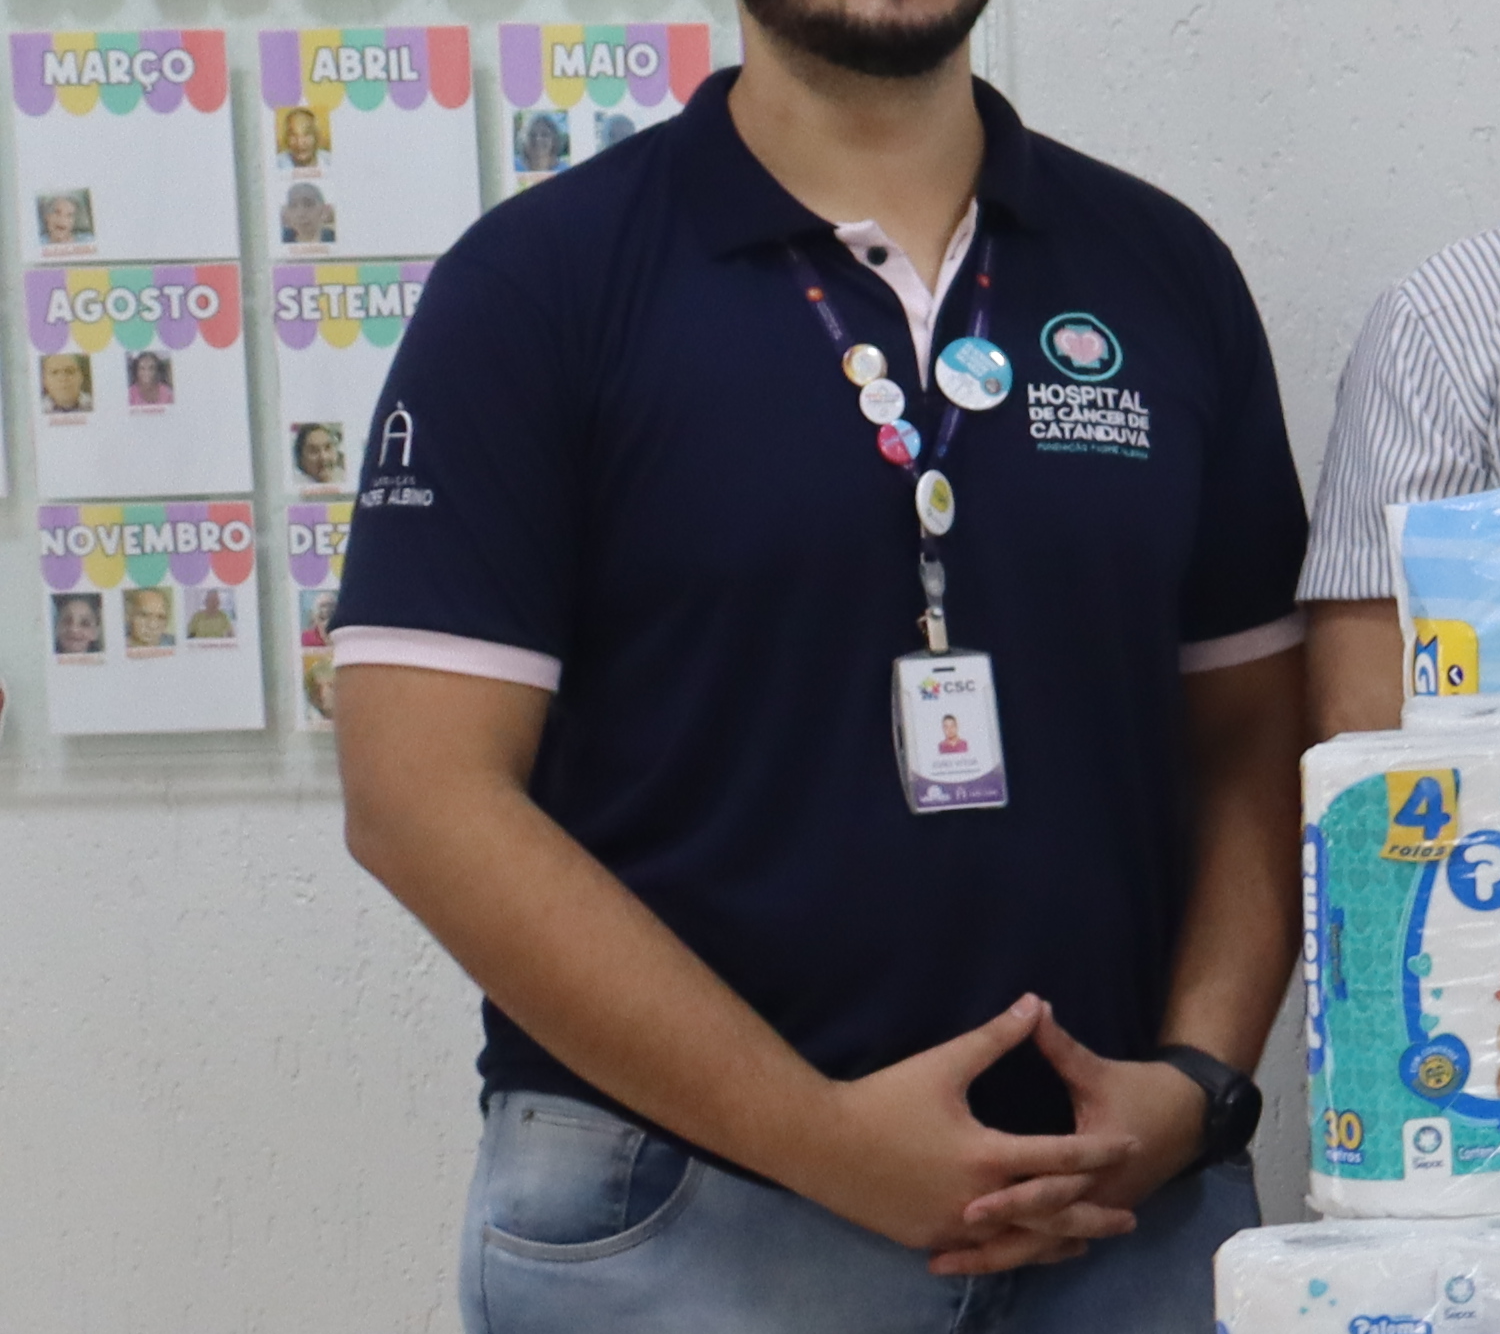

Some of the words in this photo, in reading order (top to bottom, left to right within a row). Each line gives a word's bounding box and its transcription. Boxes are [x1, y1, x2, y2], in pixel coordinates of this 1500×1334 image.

[42, 47, 196, 93] MARÇO
[310, 45, 420, 83] ABRIL
[552, 42, 659, 78] MAIO
[46, 284, 219, 324] AGOSTO
[1027, 382, 1149, 415] HOSPITAL
[1029, 406, 1055, 421] DE
[1057, 403, 1126, 427] CÂNCER
[1128, 413, 1149, 431] DE
[1029, 421, 1150, 449] CATANDUVA
[40, 520, 252, 556] NOVEMBRO
[943, 679, 977, 694] CSC
[1394, 776, 1451, 841] 4
[1388, 841, 1449, 859] rolos
[1321, 1107, 1365, 1151] 30
